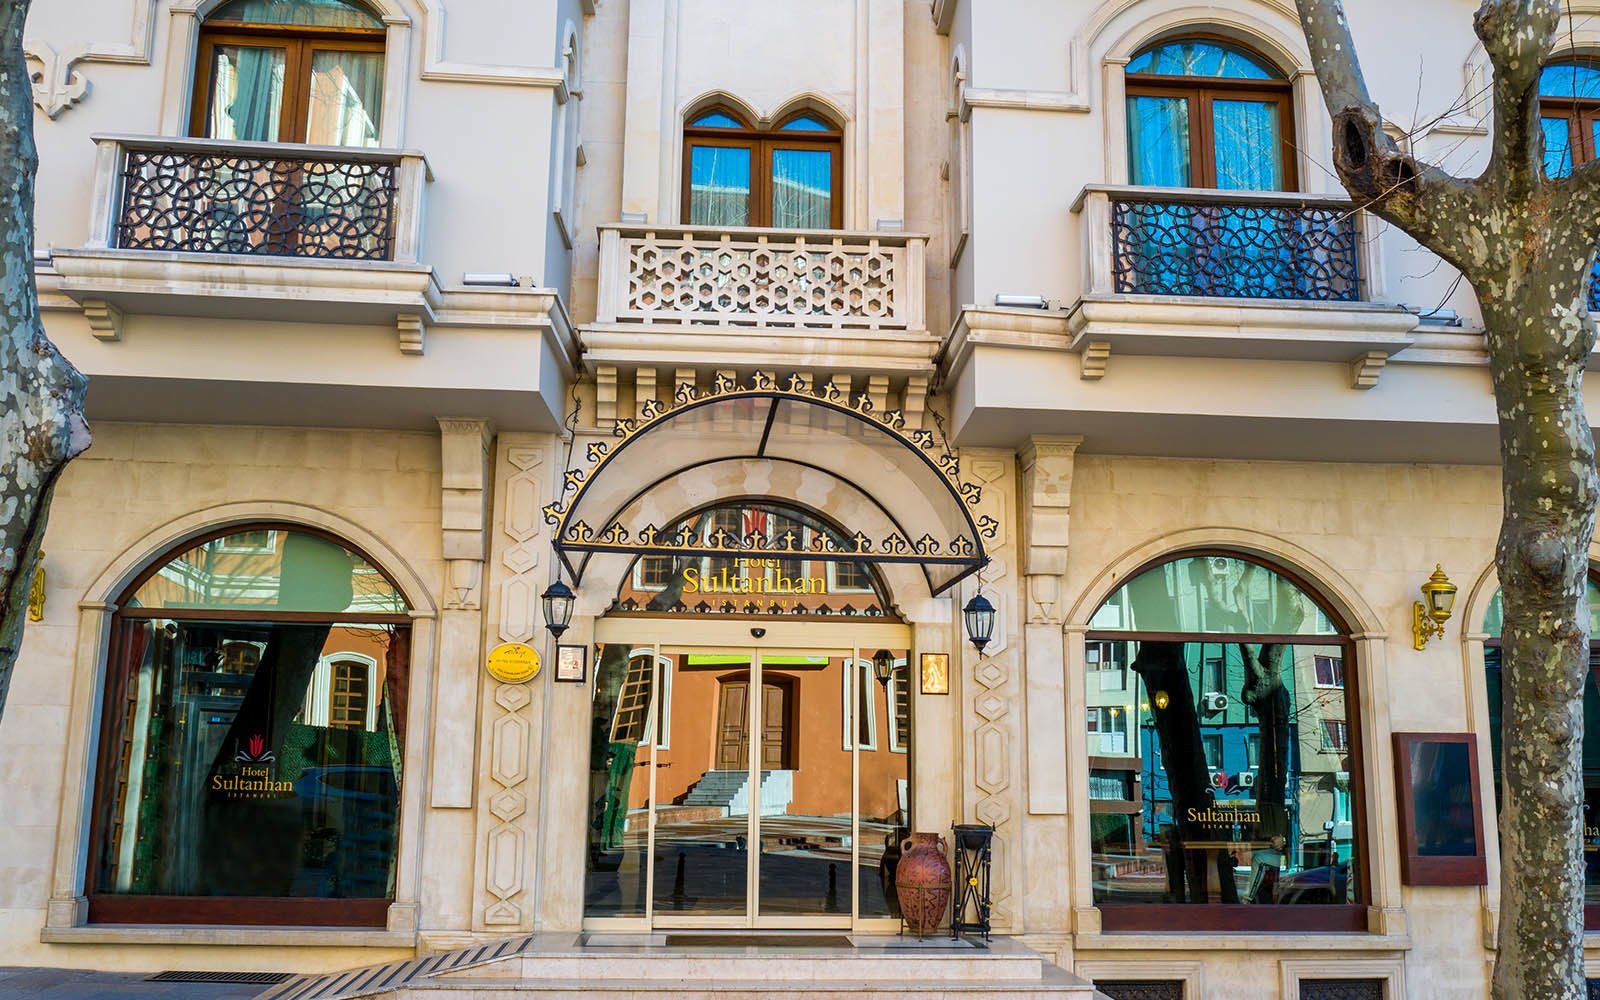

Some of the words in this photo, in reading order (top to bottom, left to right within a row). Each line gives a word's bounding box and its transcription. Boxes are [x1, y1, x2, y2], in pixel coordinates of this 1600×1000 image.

[682, 567, 827, 594] Sultanhan
[241, 766, 269, 777] Hotel
[212, 774, 293, 792] Sultanhan
[1187, 807, 1261, 823] Sultanhan
